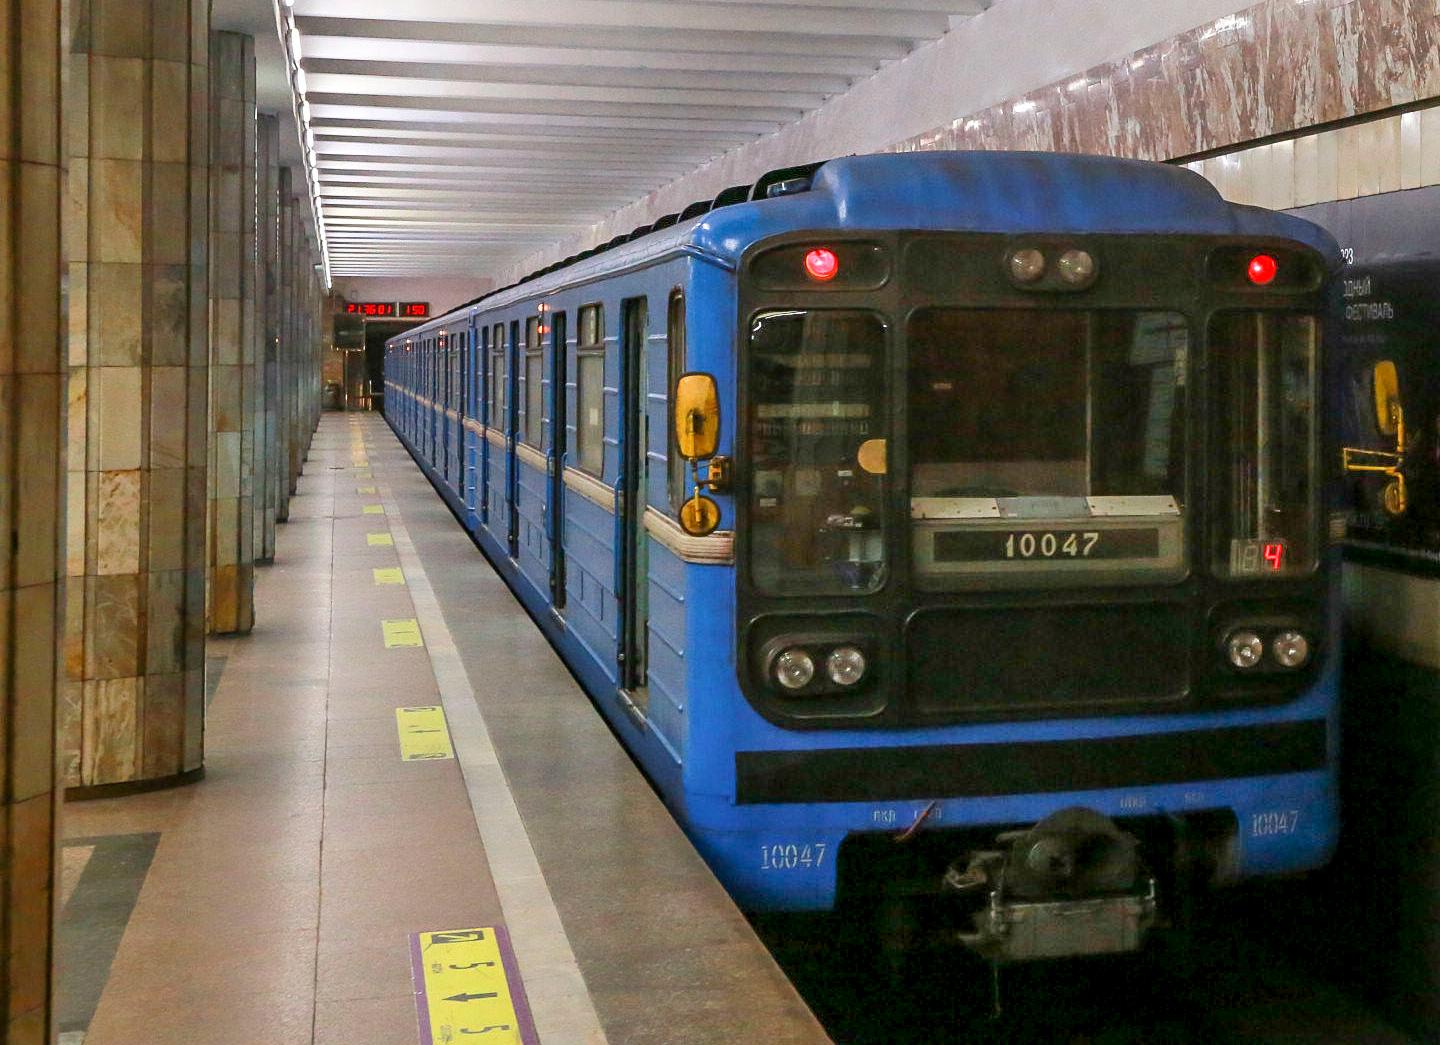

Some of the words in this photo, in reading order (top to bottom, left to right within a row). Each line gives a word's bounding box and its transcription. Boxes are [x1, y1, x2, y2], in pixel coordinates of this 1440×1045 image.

[1006, 532, 1099, 558] 10047
[1264, 544, 1282, 570] 4
[1252, 811, 1299, 837] 10047
[761, 844, 825, 870] 10047
